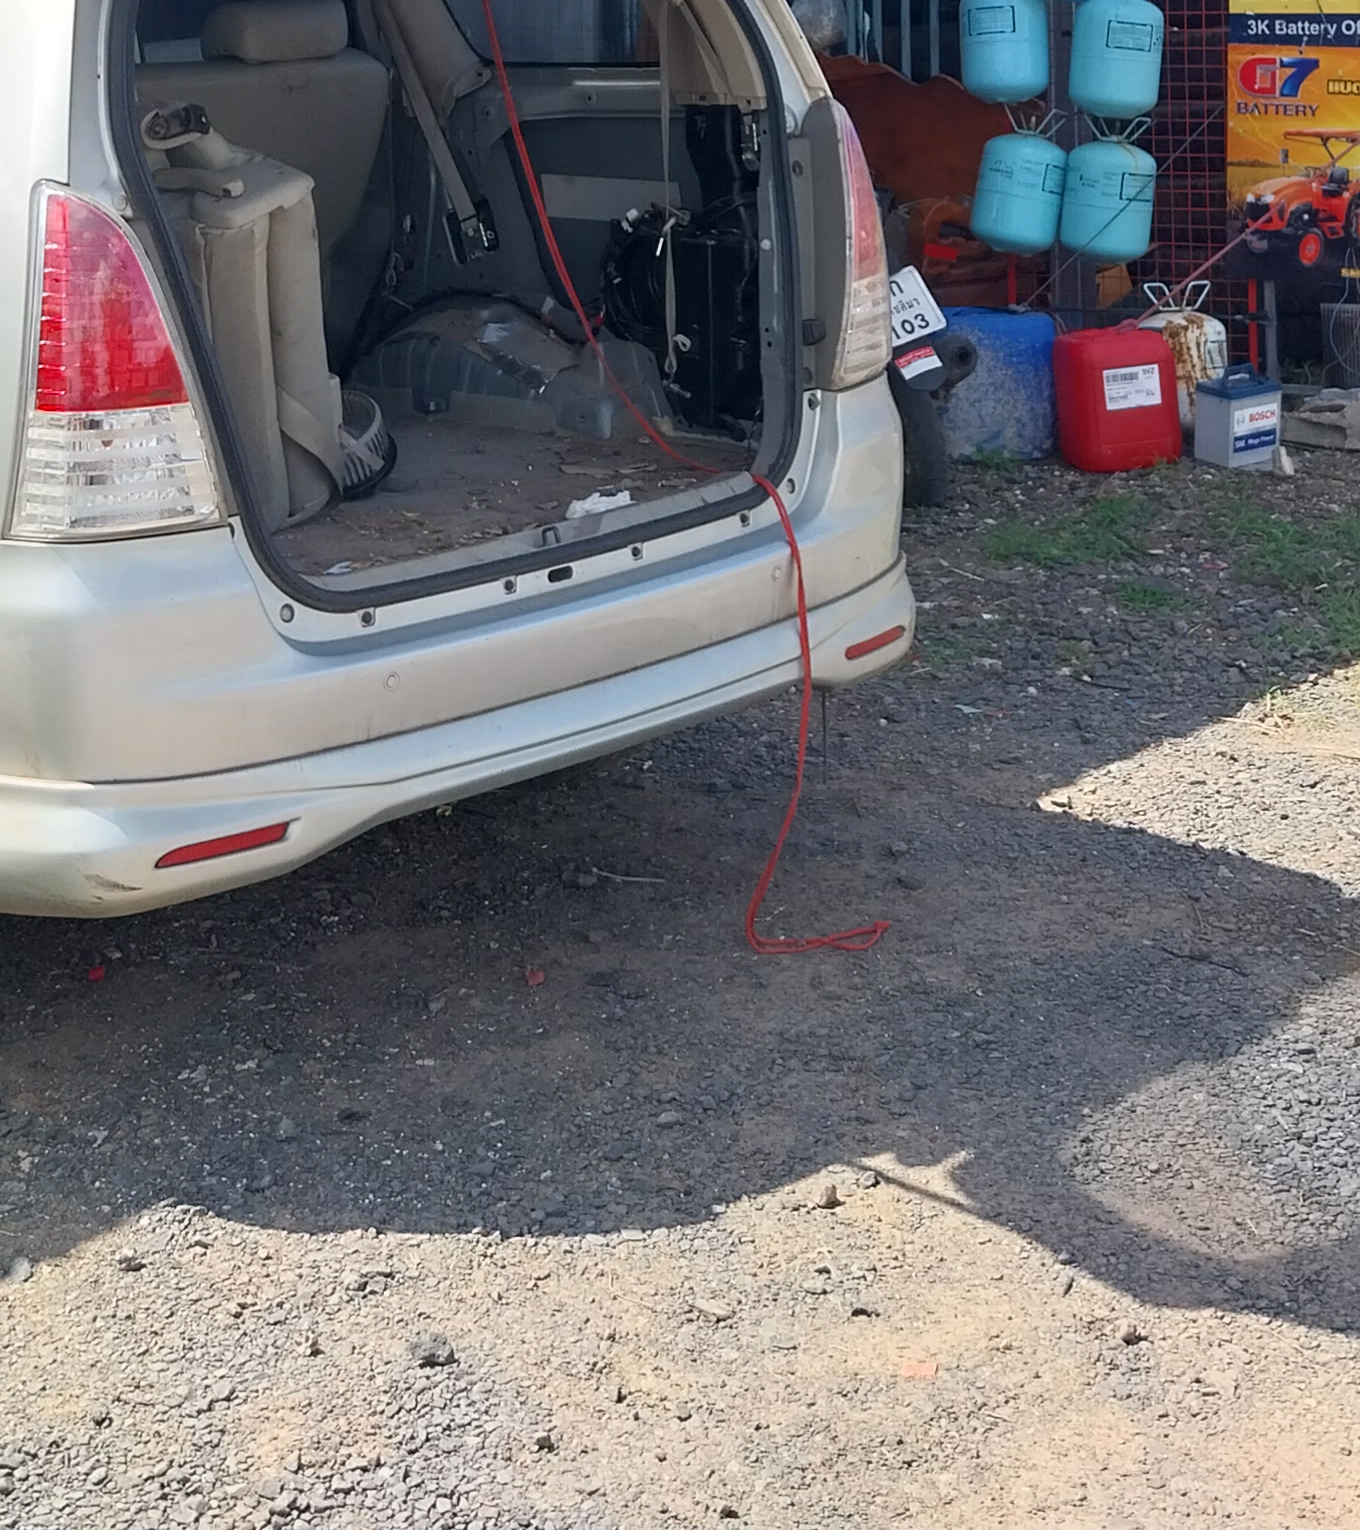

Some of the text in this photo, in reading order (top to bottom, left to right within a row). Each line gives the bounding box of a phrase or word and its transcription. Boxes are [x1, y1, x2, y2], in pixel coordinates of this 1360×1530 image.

[1247, 20, 1270, 36] 3K
[1275, 20, 1337, 41] Battery
[1236, 101, 1320, 117] BATTERY
[1248, 409, 1276, 423] BOSCH
